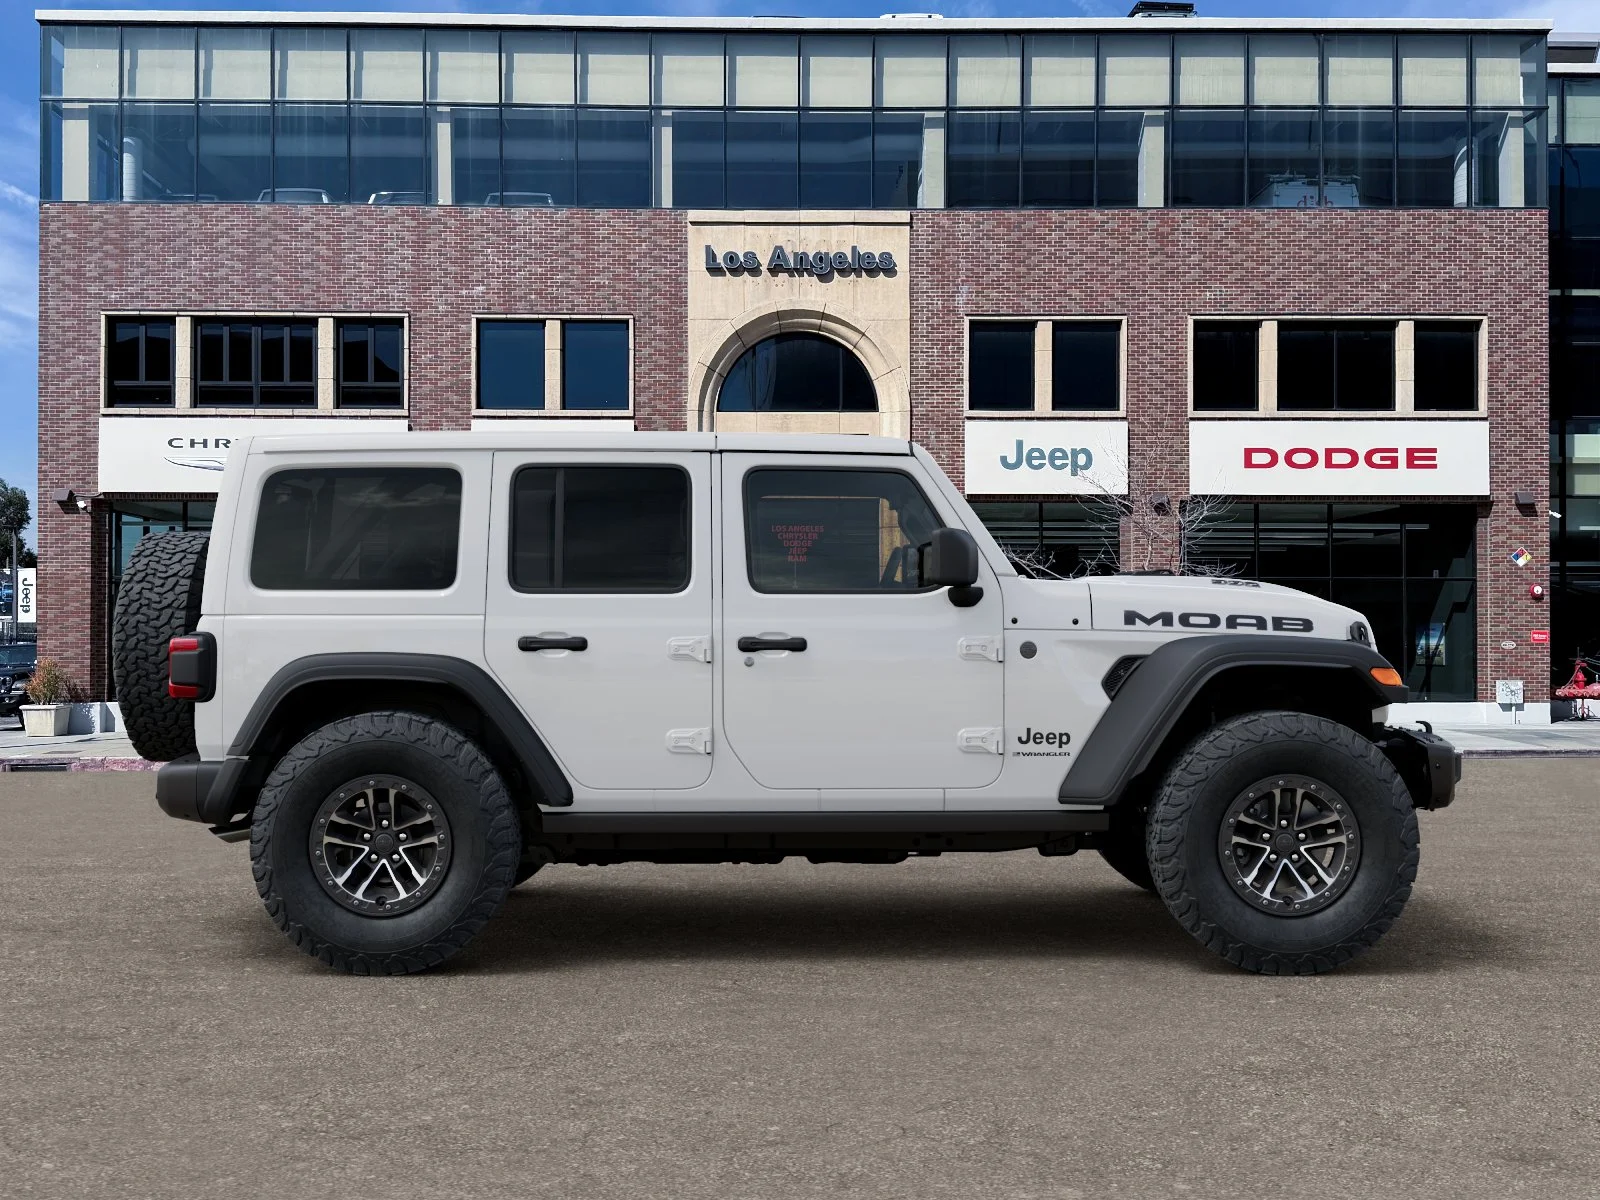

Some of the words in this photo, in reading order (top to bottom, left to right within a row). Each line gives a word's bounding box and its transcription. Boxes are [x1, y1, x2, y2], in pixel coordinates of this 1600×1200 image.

[705, 245, 758, 268] Los
[767, 245, 894, 275] Angeles
[167, 437, 239, 449] CHR
[1000, 439, 1093, 476] Jeep
[1244, 447, 1438, 470] DODGE
[20, 577, 34, 614] Jeep
[1123, 610, 1314, 633] MOAB
[1017, 727, 1071, 748] Jeep
